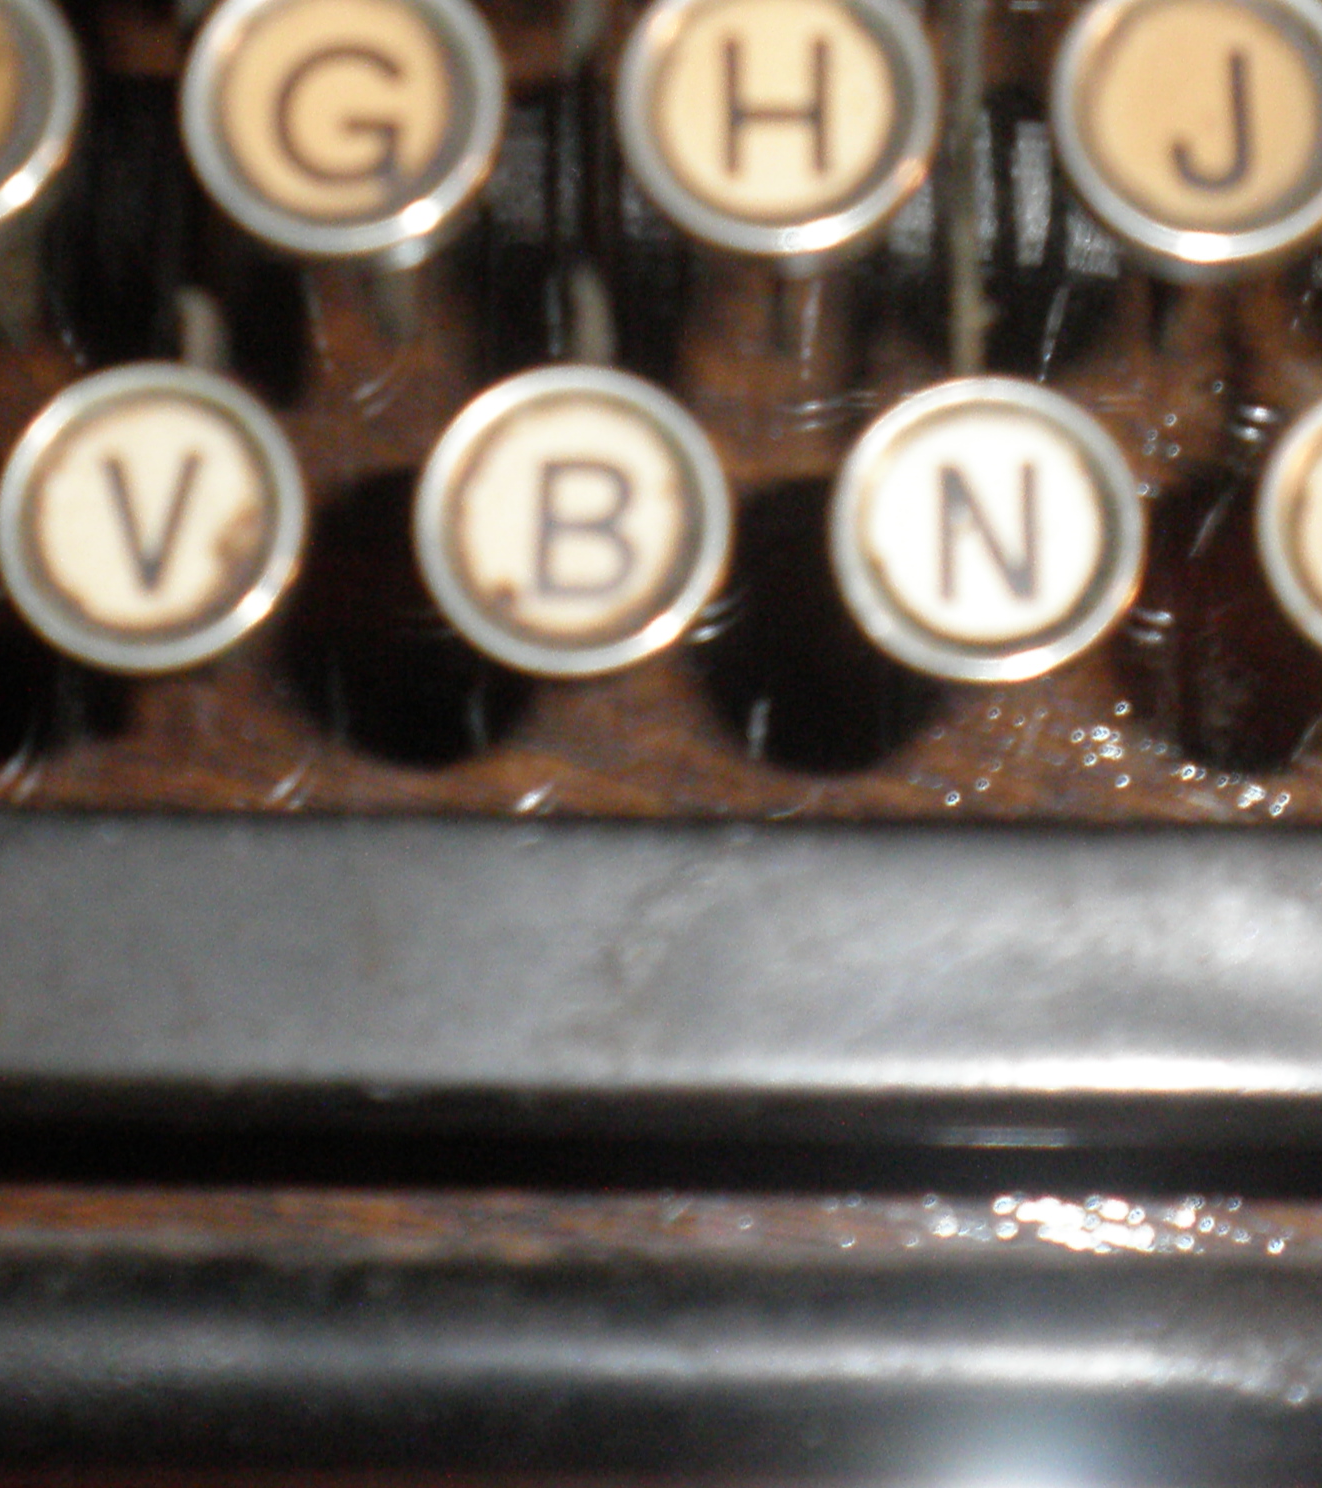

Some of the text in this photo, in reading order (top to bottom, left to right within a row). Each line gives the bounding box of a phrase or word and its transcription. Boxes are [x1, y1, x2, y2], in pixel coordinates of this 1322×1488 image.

[277, 44, 405, 189] G
[718, 32, 833, 179] H
[1169, 47, 1251, 192] J
[100, 449, 203, 598] V
[533, 457, 636, 600] B
[939, 460, 1038, 606] N
